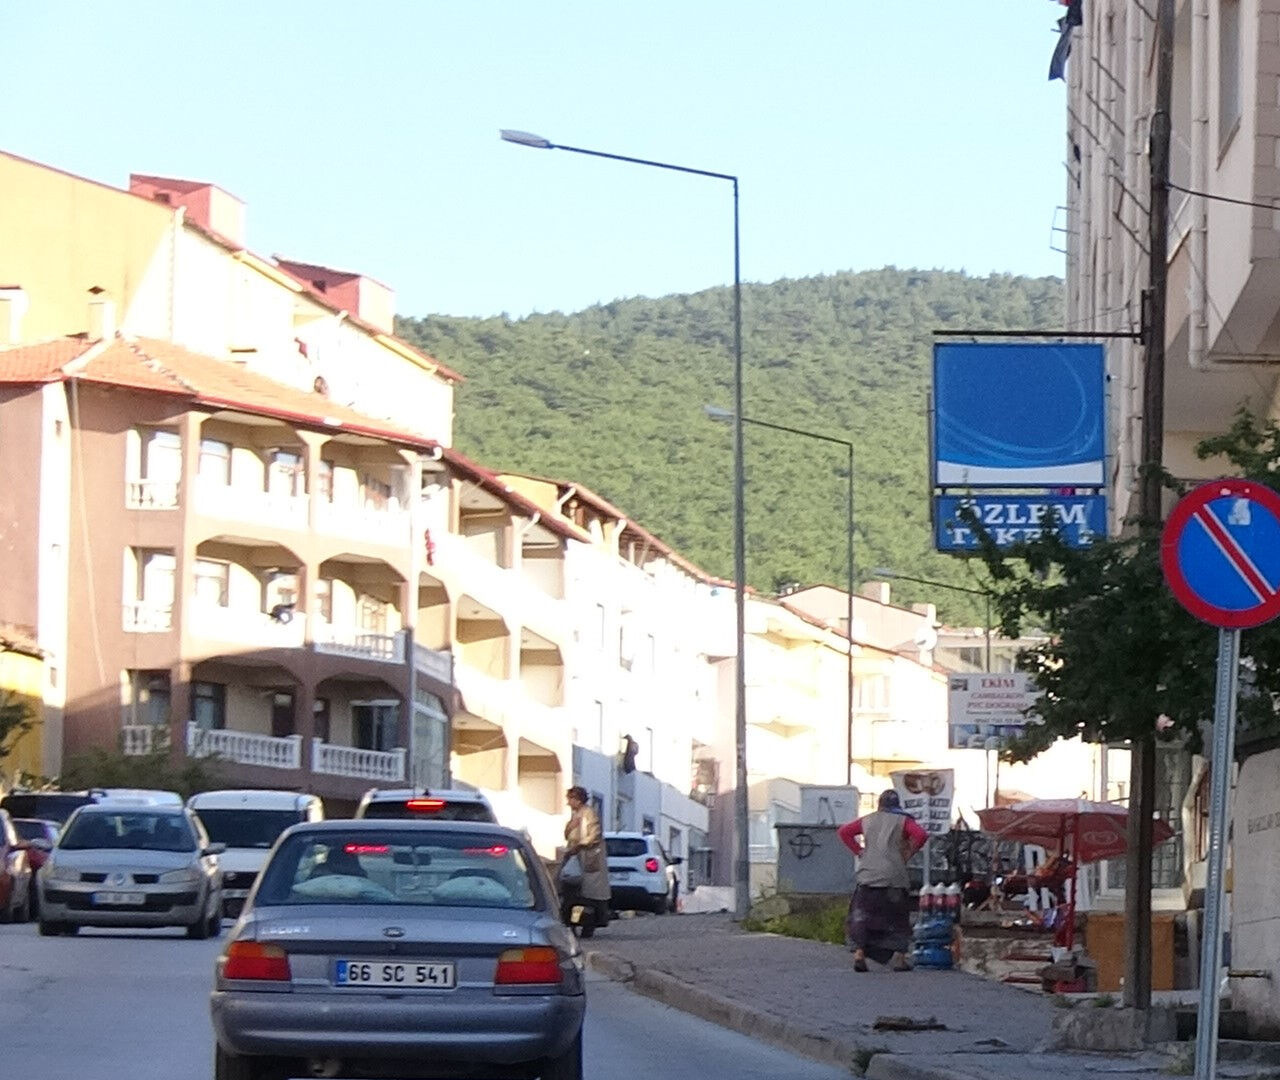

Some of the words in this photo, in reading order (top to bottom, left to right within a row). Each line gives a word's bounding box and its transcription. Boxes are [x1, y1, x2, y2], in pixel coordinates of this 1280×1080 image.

[955, 499, 1085, 524] ÖZLEM
[348, 963, 372, 982] 66
[382, 965, 405, 982] SC
[416, 966, 449, 984] 541
